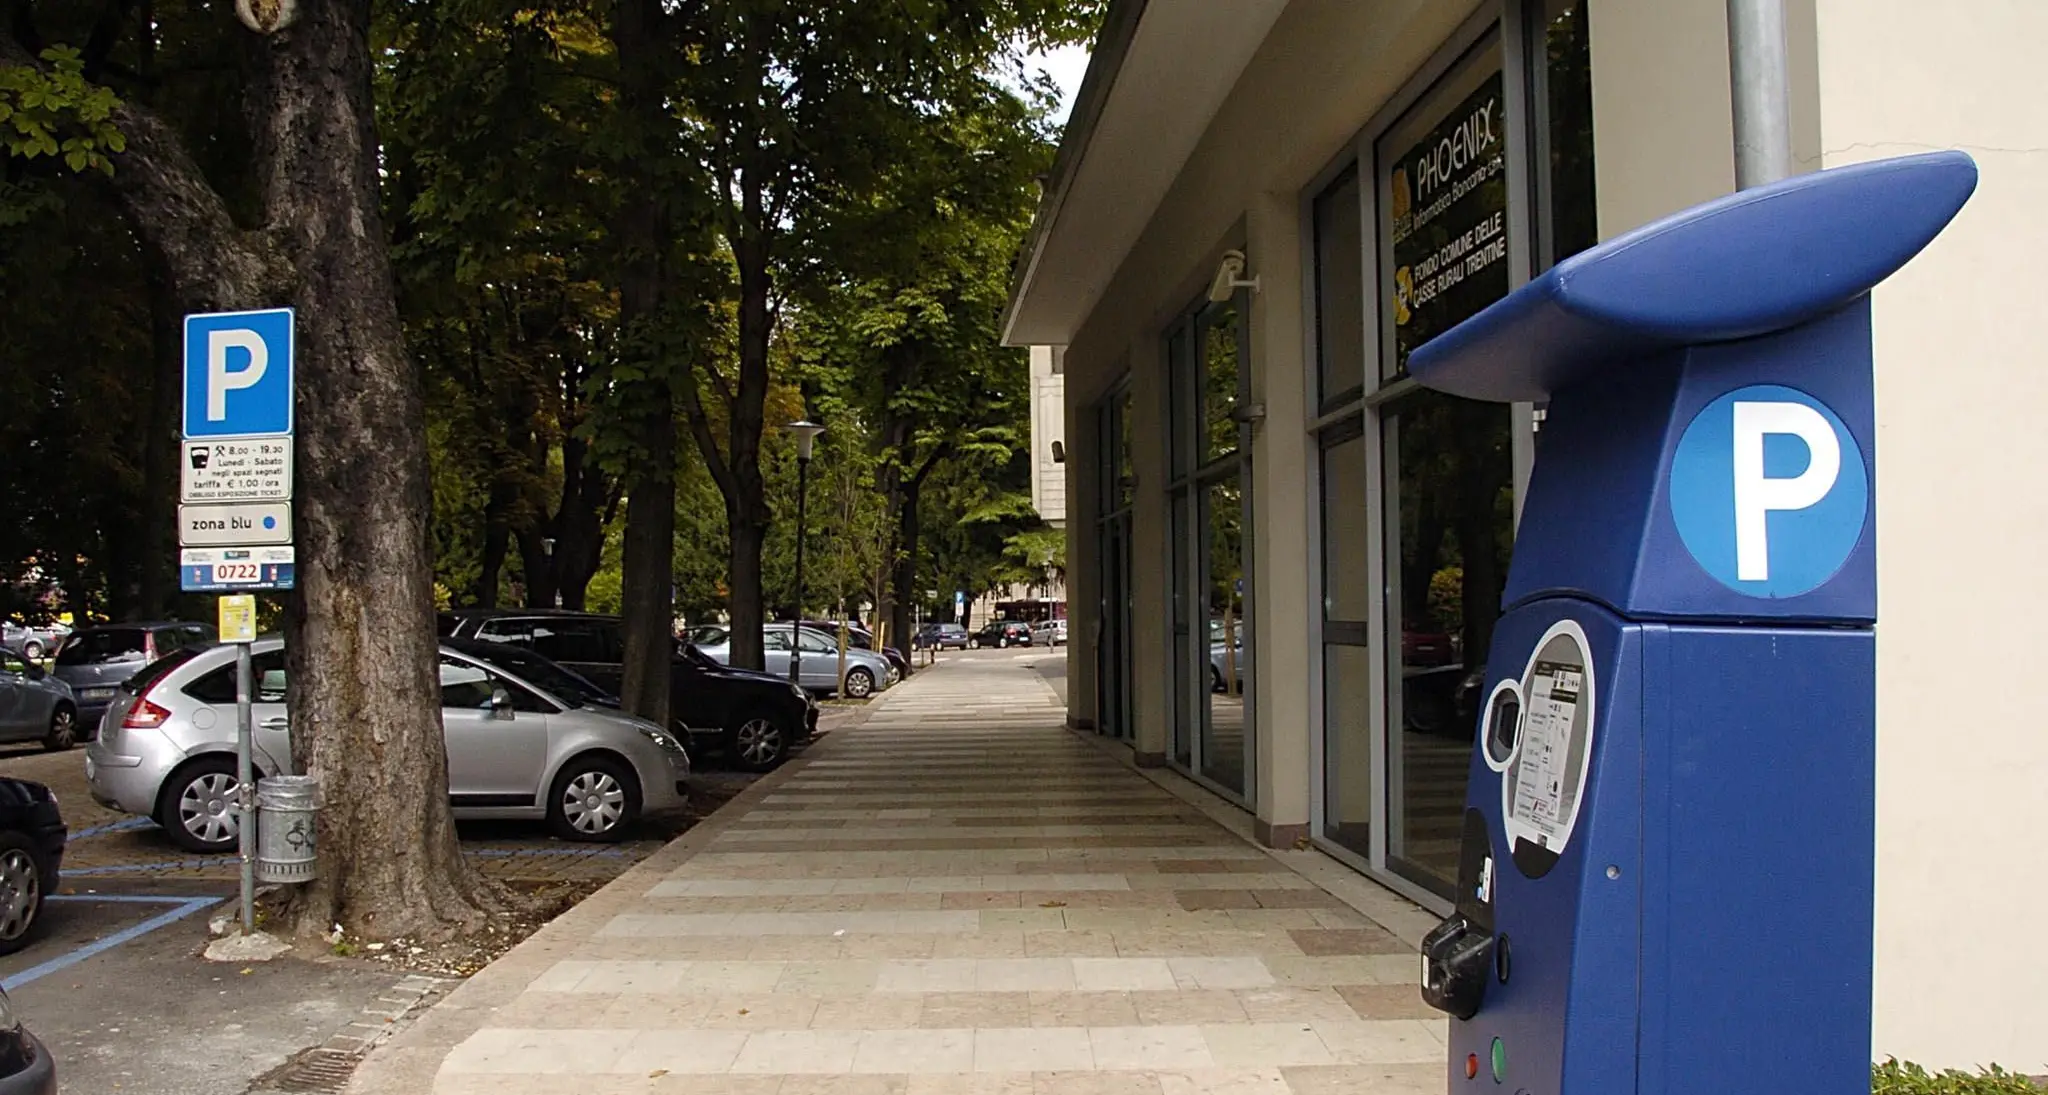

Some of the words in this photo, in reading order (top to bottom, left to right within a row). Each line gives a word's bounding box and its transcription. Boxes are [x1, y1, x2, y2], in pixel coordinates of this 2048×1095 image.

[1417, 98, 1495, 200] PHOENIX
[1415, 253, 1439, 283] FONDO
[1440, 230, 1473, 266] COMUNE
[1474, 212, 1502, 245] DELLE
[1413, 279, 1437, 308] CASSE
[1438, 262, 1464, 292] RURALI
[1465, 236, 1505, 276] TRENTINE
[208, 329, 269, 421] P
[229, 446, 249, 455] 8.00
[254, 457, 283, 466] Sabato
[212, 470, 230, 478] negli
[233, 469, 252, 478] spazi
[255, 468, 283, 477] segnati
[194, 480, 220, 489] tariffa
[227, 479, 234, 489] €
[1733, 401, 1841, 581] P
[192, 519, 225, 530] zona
[231, 515, 252, 529] blu
[218, 564, 258, 579] 0722
